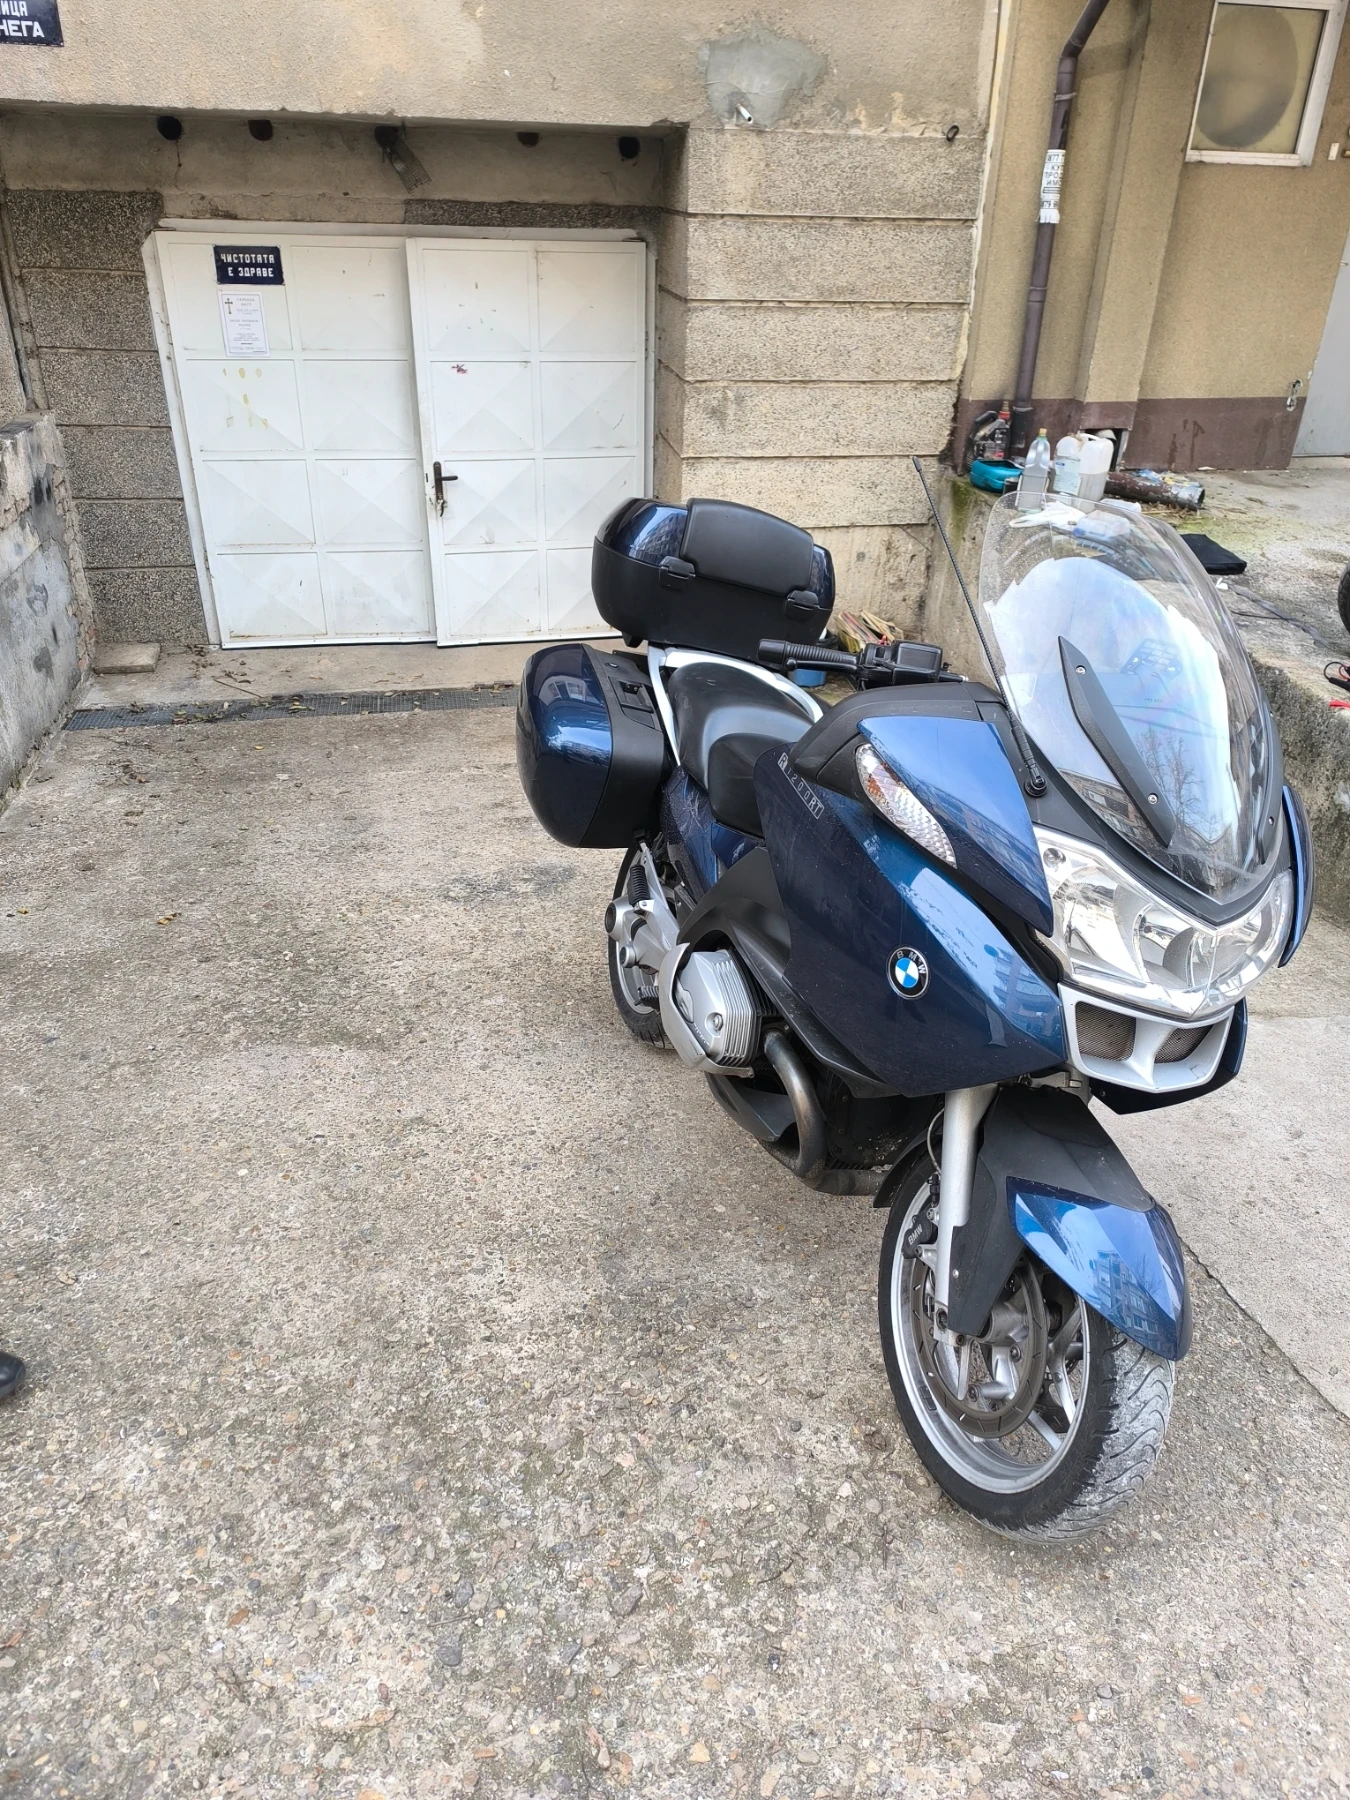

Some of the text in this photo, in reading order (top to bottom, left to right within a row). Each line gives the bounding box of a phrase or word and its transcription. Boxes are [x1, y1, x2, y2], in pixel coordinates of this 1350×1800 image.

[0, 0, 28, 17] ИЦА
[220, 253, 275, 264] ЧИСТОТАТА
[227, 267, 274, 277] Е ЗДРАВЕ
[896, 950, 927, 974] BMW
[908, 1223, 922, 1245] BMW
